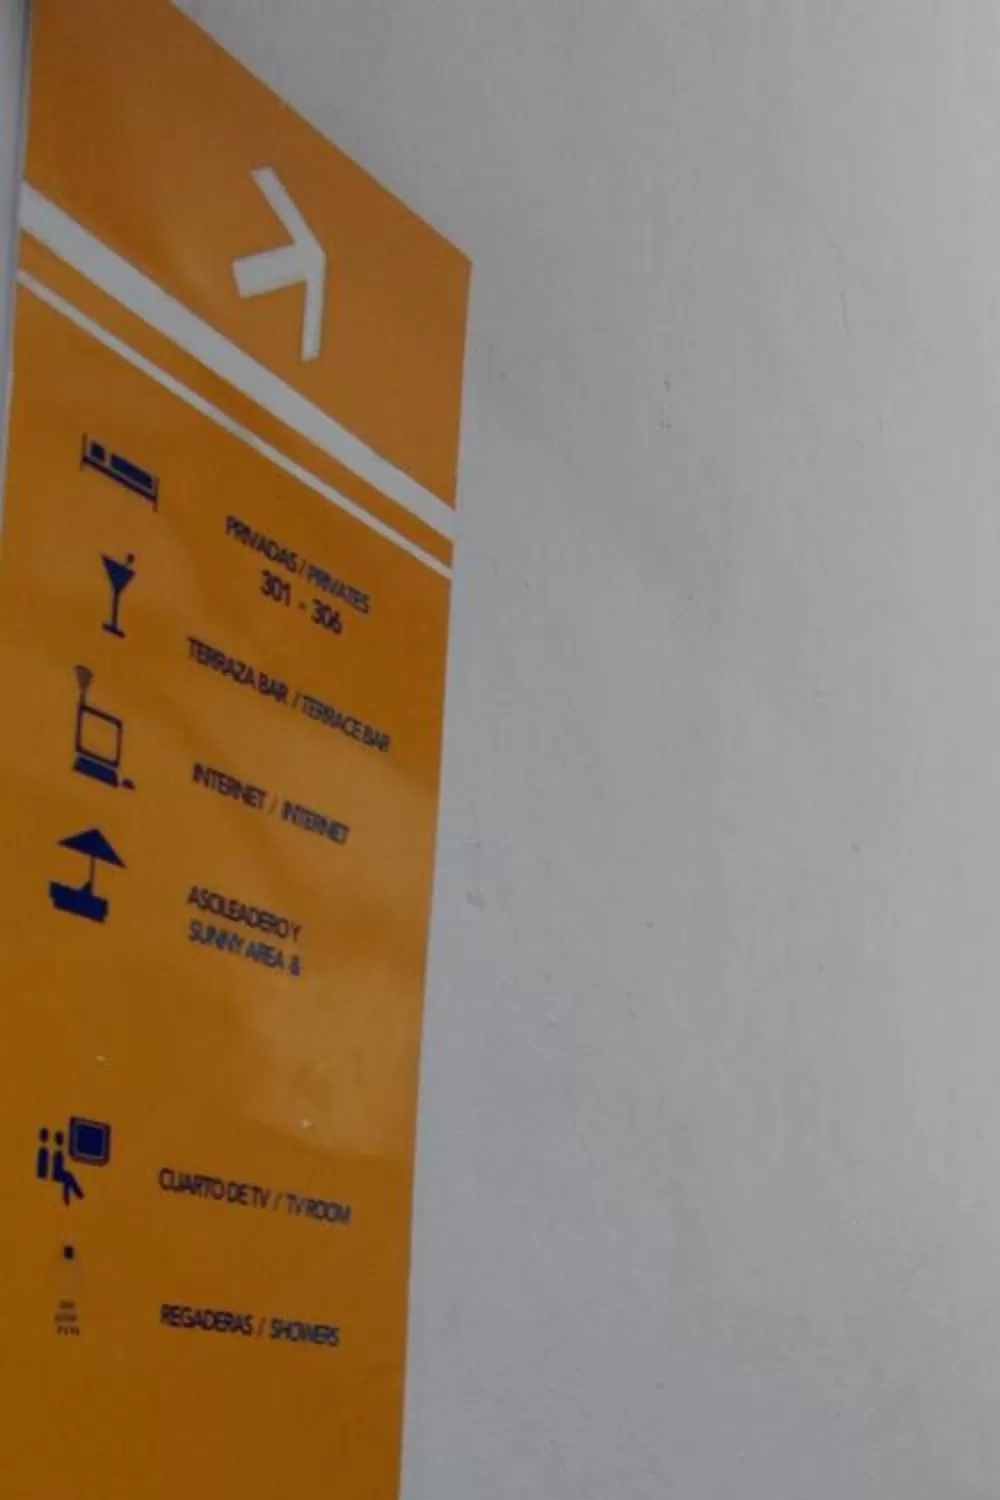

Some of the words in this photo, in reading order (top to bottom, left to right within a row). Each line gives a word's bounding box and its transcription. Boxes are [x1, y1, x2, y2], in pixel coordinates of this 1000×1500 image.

[225, 515, 298, 573] PRIVADAS
[307, 564, 370, 614] PRIVATES
[260, 569, 291, 607] 301
[311, 598, 342, 635] 306
[187, 634, 256, 688] TERRAZA
[258, 671, 289, 704] BAR
[300, 693, 363, 741] TERRACE
[363, 723, 391, 752] BAR
[192, 762, 267, 810] INTERNET
[281, 799, 351, 846] INTERNET
[187, 885, 290, 939] ASOLEADERO
[189, 919, 246, 953] SUNNY
[245, 939, 285, 969] AREA
[158, 1167, 226, 1201] CUARTO
[227, 1180, 248, 1206] DE
[248, 1184, 270, 1210] TV
[285, 1193, 304, 1216] TV
[303, 1197, 352, 1225] ROOM
[159, 1303, 255, 1336] REGADERAS
[269, 1317, 341, 1347] SHOWERS
